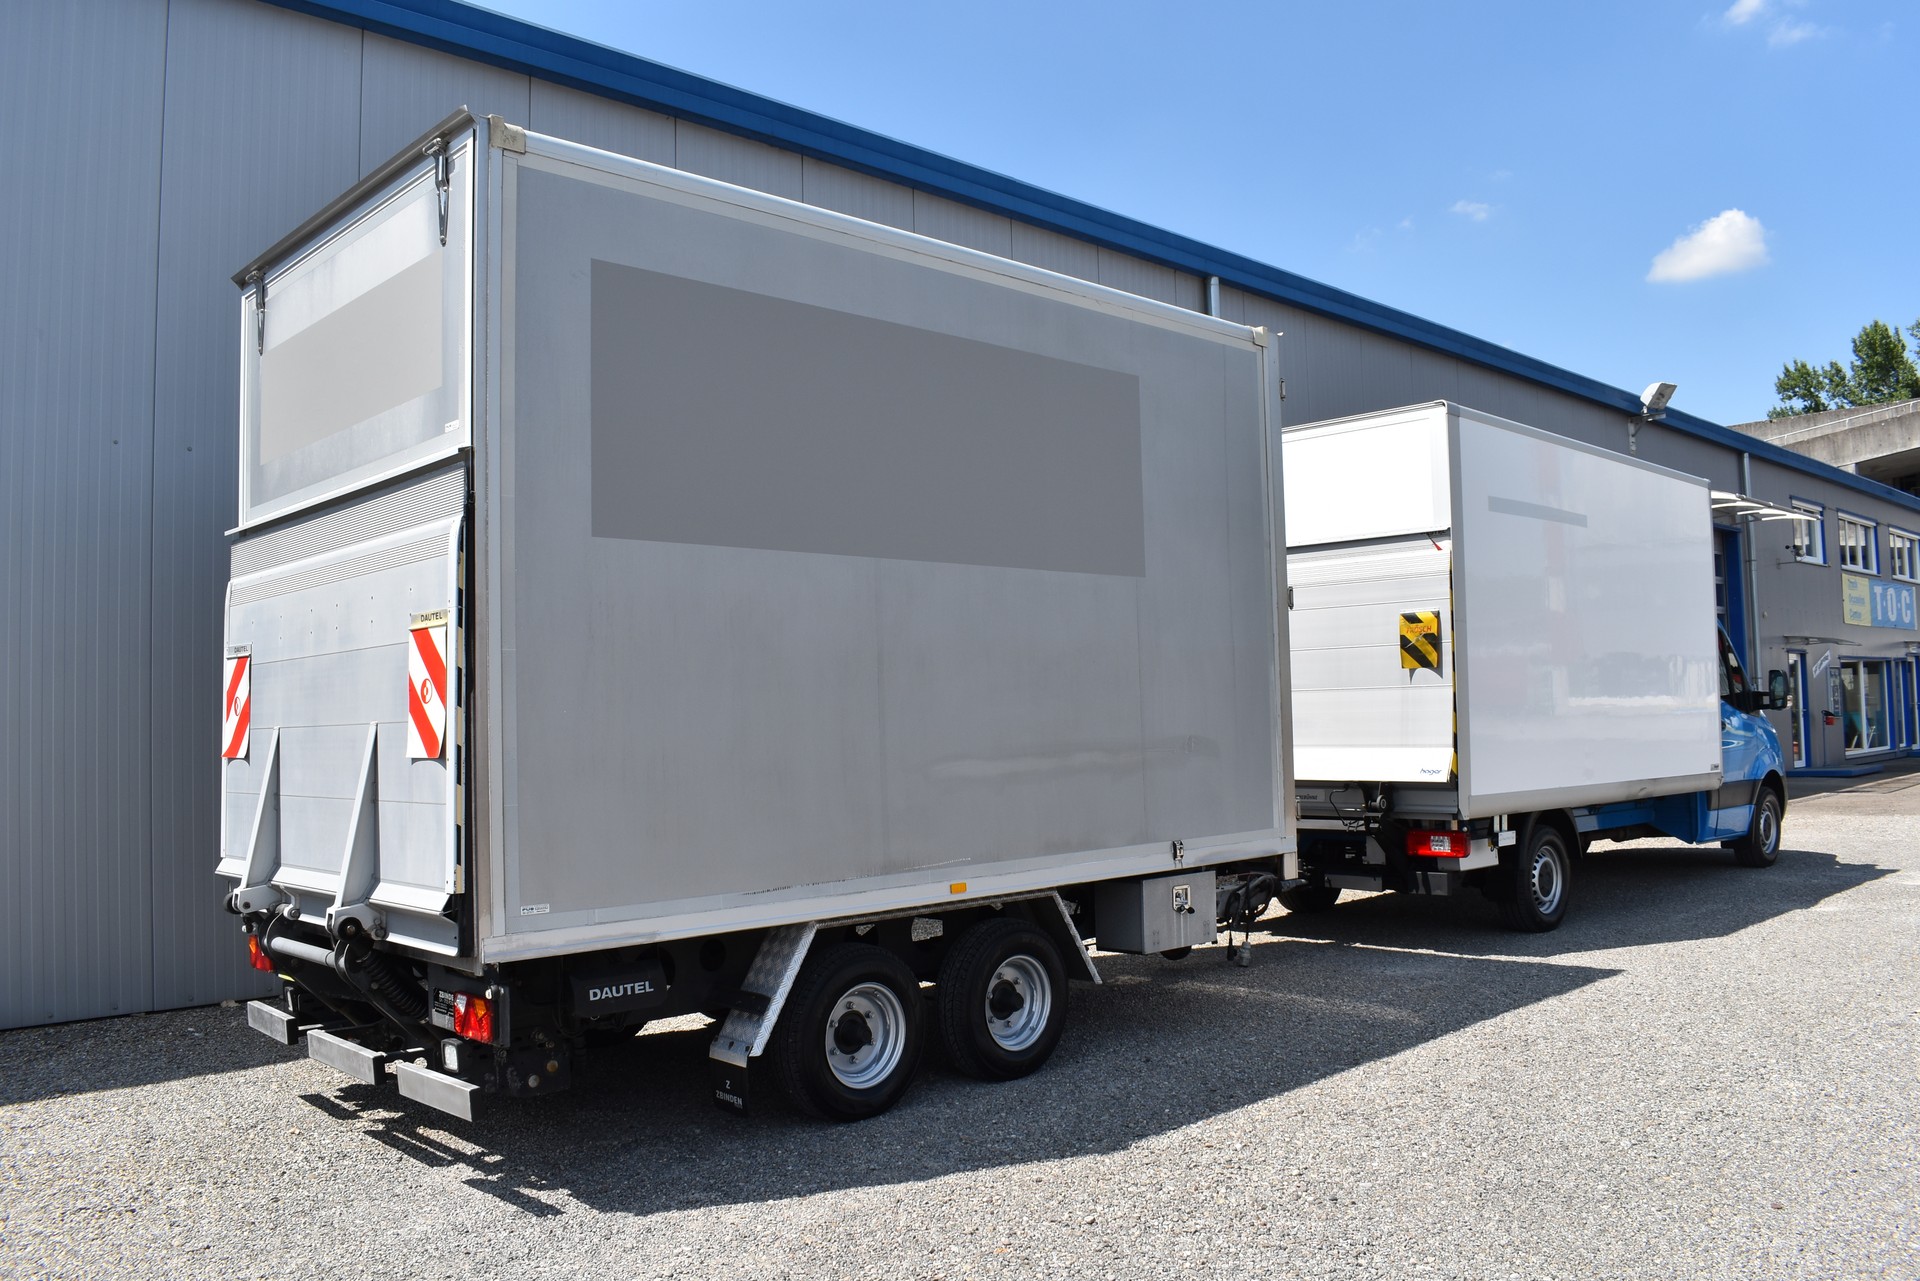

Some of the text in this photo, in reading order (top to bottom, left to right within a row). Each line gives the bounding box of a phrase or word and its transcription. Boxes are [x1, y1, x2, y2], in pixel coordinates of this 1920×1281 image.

[420, 611, 443, 623] DAUTEL
[589, 981, 654, 1001] DAUTEL
[715, 1089, 743, 1106] ZBINDEN
